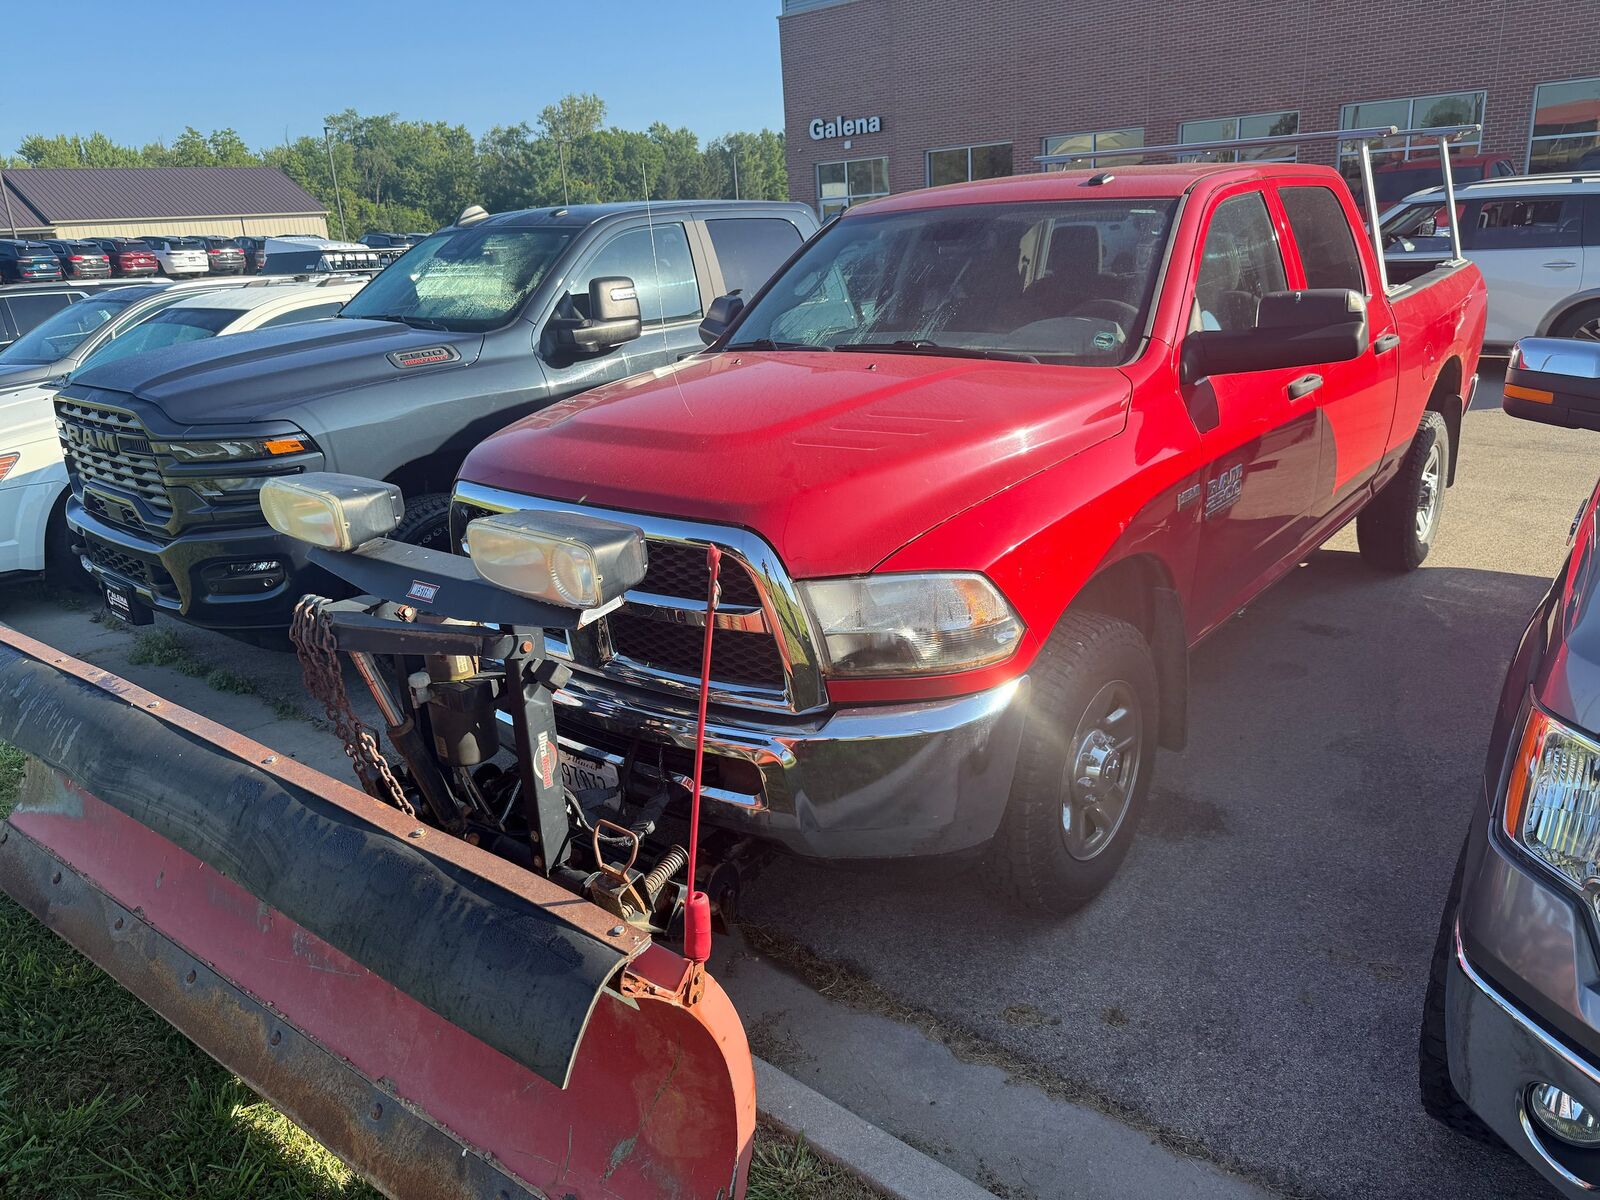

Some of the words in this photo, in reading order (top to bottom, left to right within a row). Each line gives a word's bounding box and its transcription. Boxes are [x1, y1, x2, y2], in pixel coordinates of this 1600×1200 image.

[809, 115, 880, 140] Galena
[66, 422, 118, 453] RAM
[1206, 463, 1243, 496] RAM
